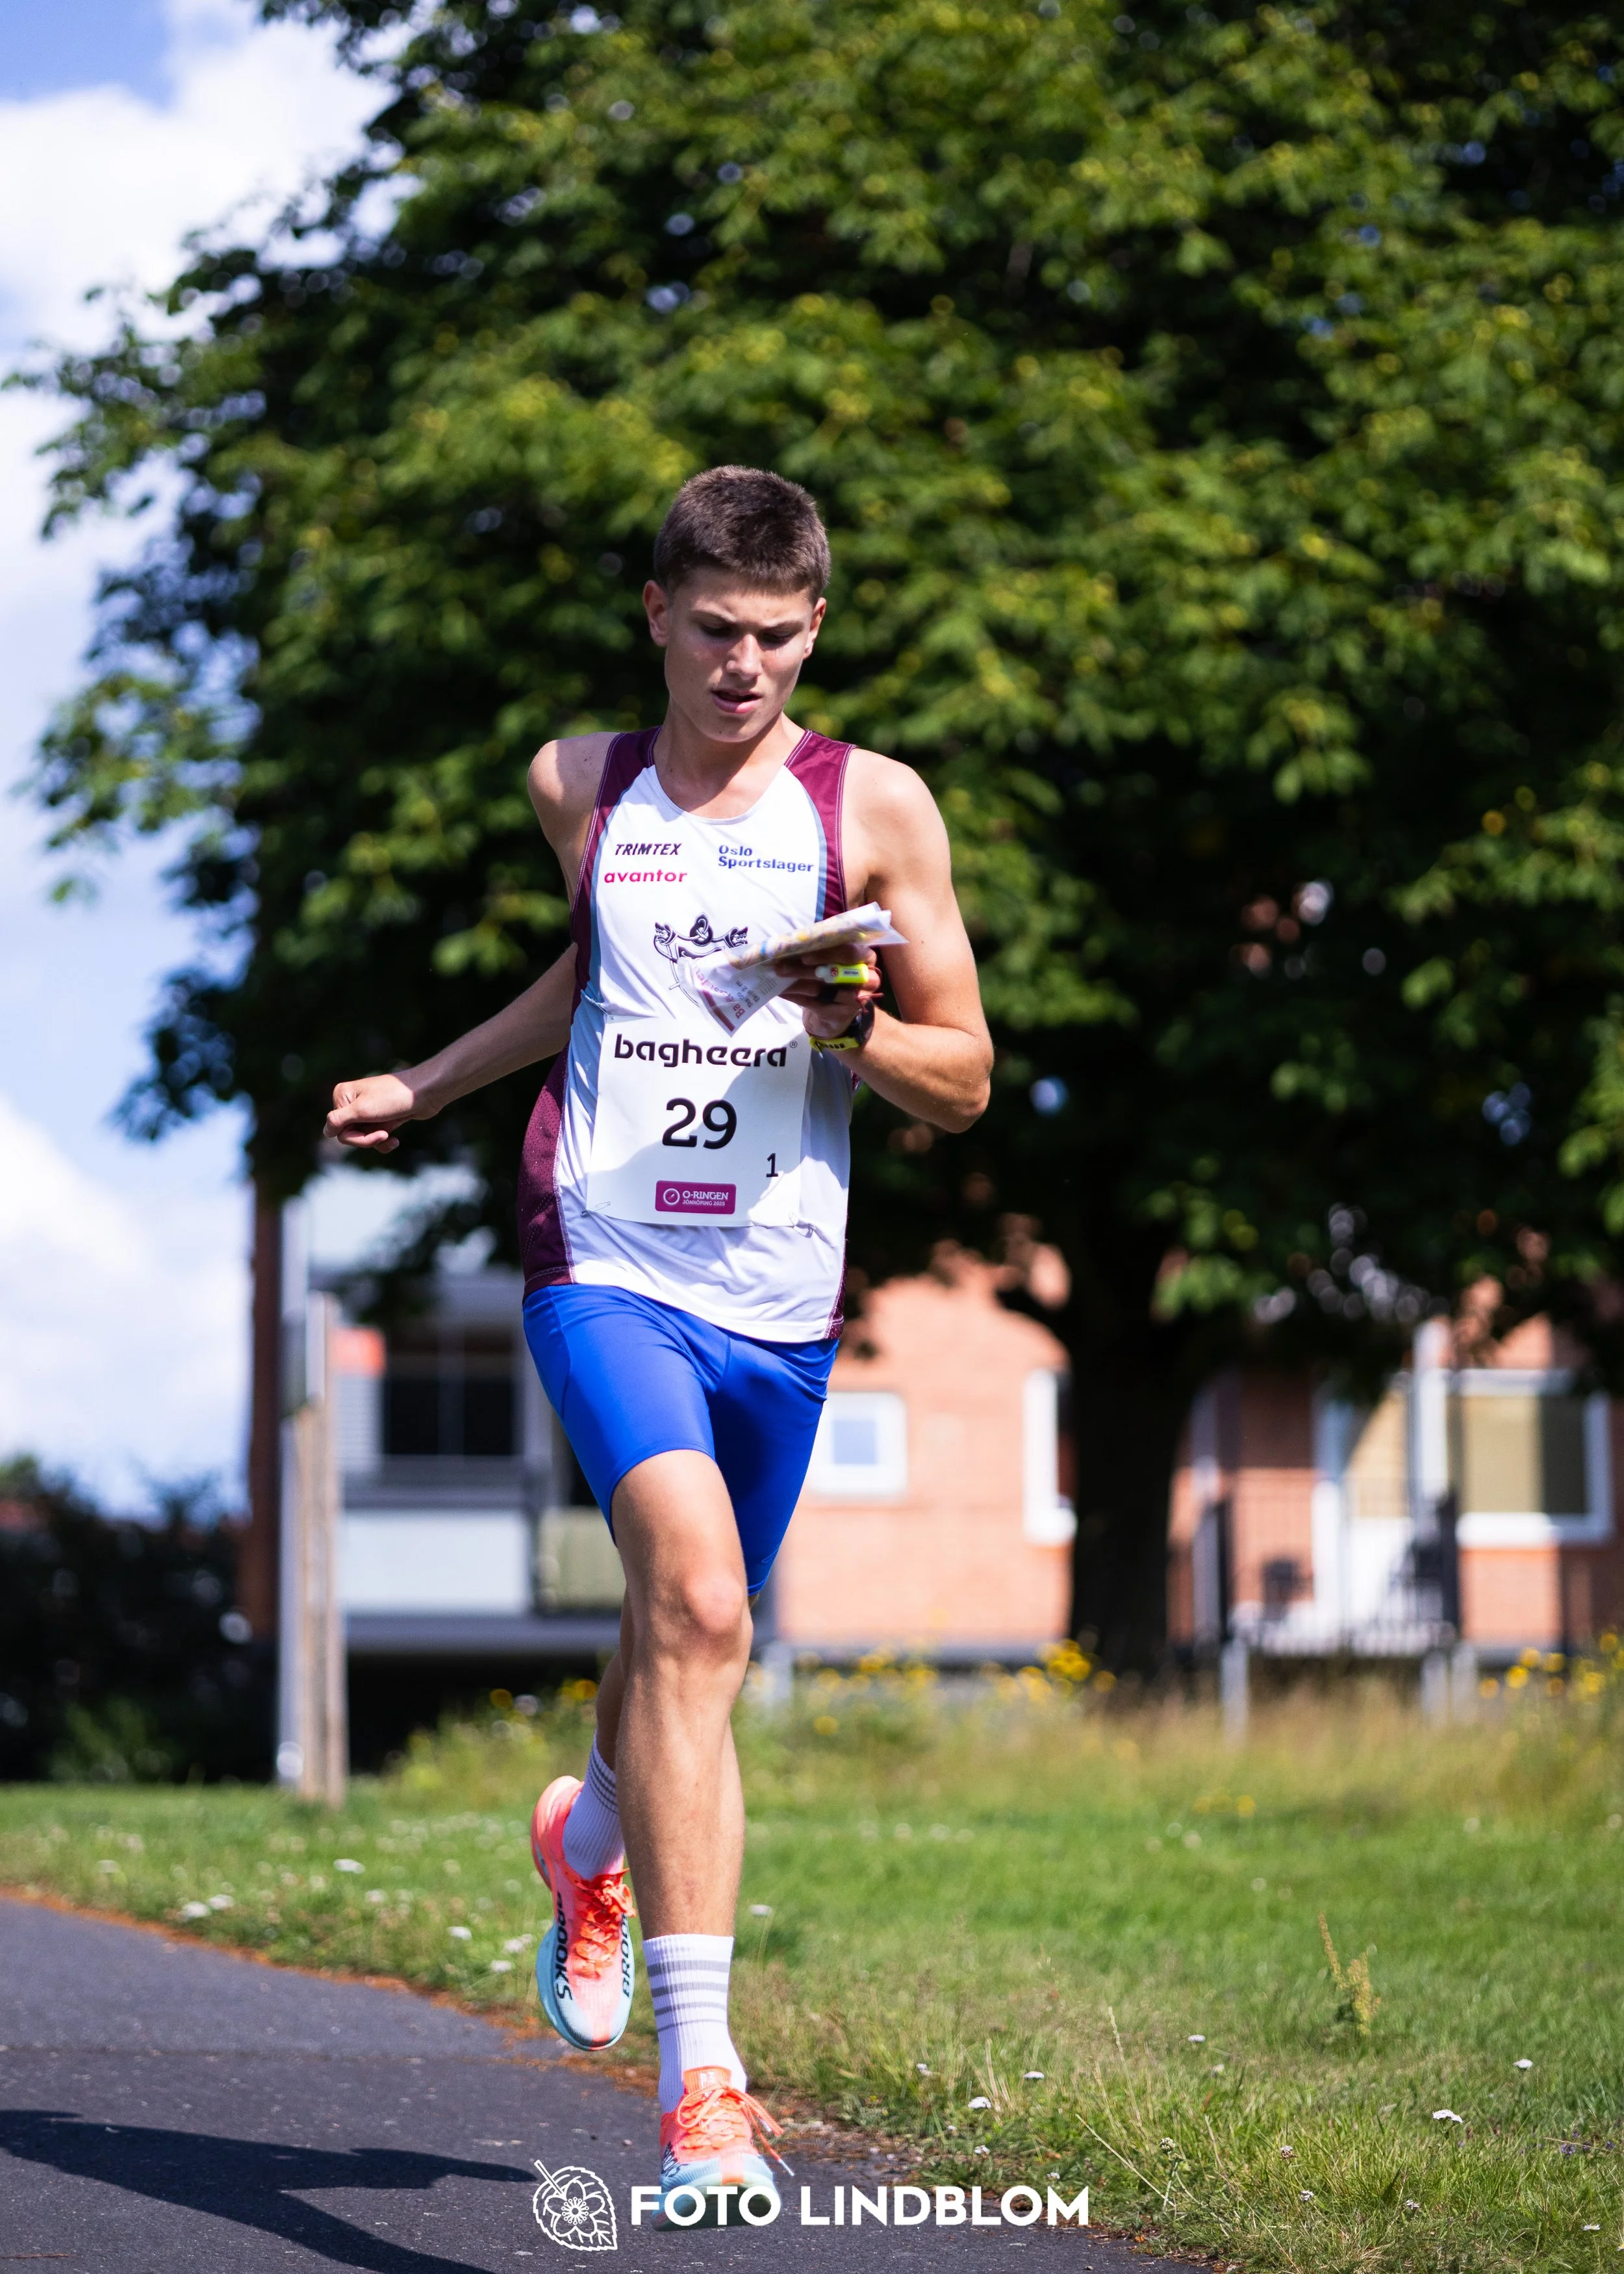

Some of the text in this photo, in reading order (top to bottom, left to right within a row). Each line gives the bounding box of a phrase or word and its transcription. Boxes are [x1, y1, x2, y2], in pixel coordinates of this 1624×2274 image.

[615, 843, 682, 855] TRIMTEX
[718, 845, 753, 856] Oslo
[718, 856, 814, 873] Sportslager
[604, 869, 687, 883] avantor
[662, 1097, 737, 1149] 29
[766, 1153, 779, 1178] 1
[683, 1190, 729, 1200] O-RINGEN
